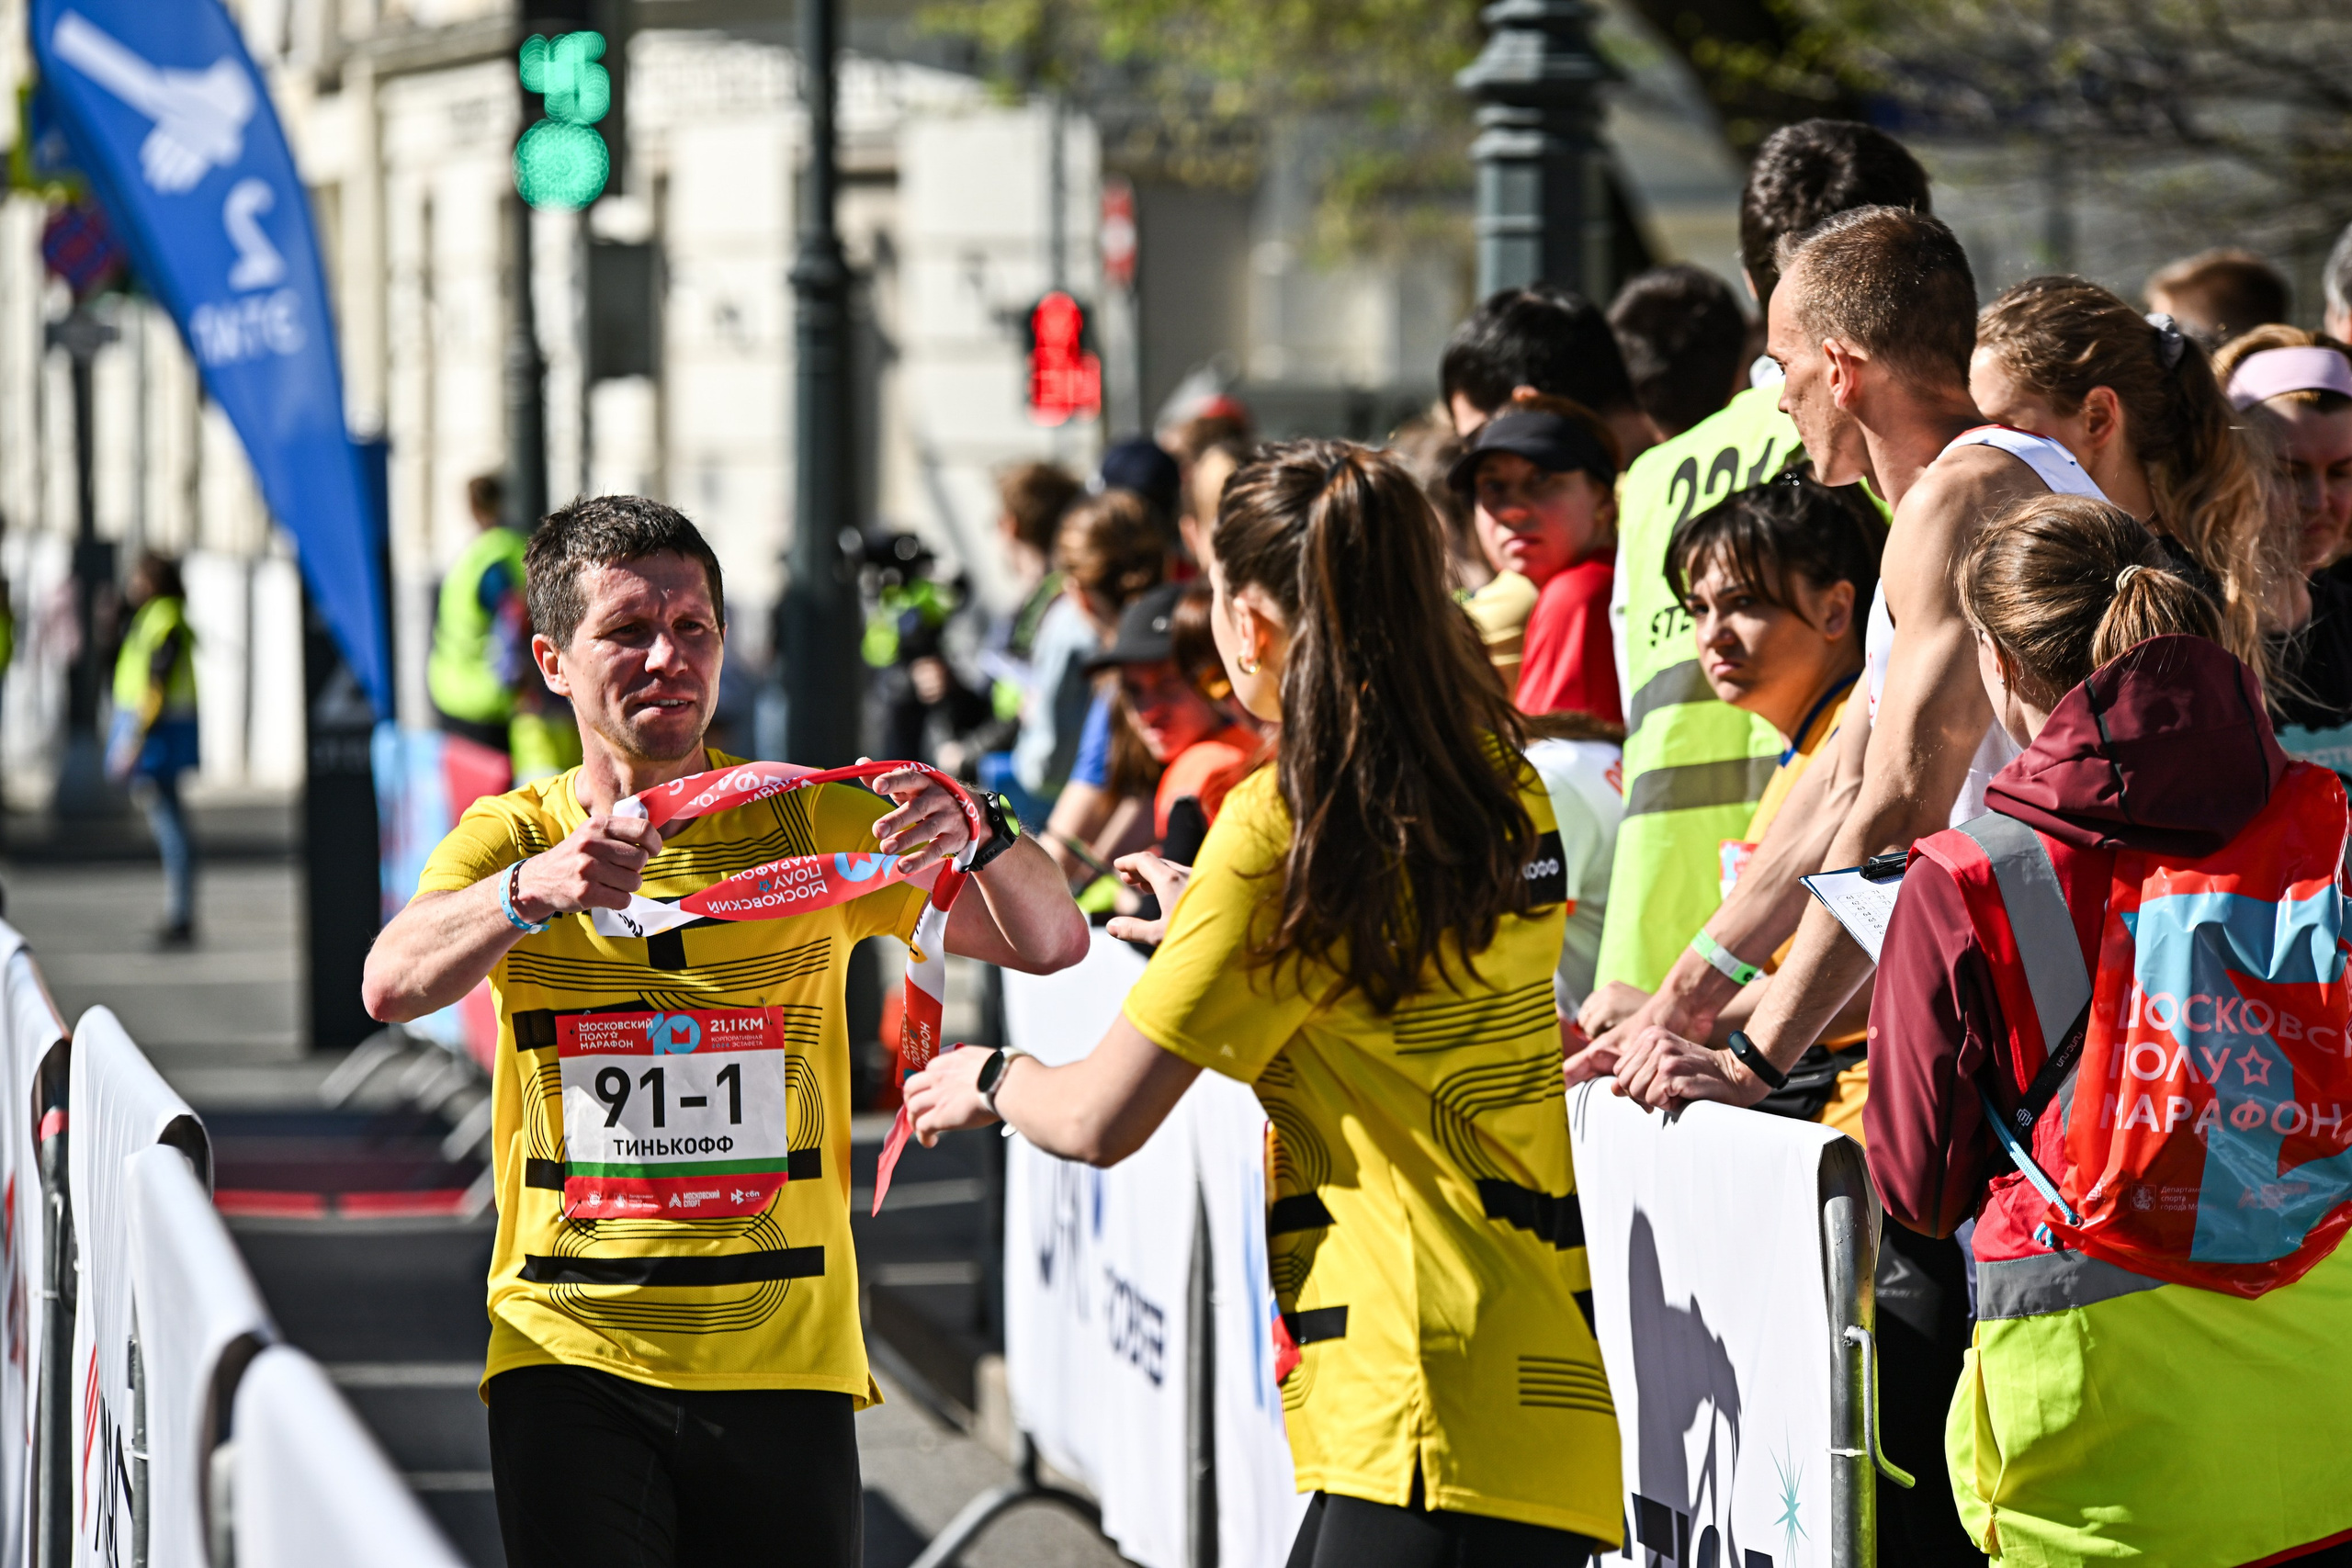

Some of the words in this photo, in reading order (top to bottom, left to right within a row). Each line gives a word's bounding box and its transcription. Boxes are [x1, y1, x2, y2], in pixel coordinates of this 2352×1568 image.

[774, 863, 822, 890] ПОЛУ
[707, 879, 829, 914] МОСКОВСКИЙ
[578, 1017, 653, 1032] МОСКОВСКИЙ
[710, 1020, 737, 1034] 21,1
[738, 1017, 763, 1031] КМ
[579, 1031, 611, 1042] ПОЛУ
[711, 1033, 763, 1043] КОРПОРАТИВНАЯ
[580, 1039, 634, 1051] МАРАФОН
[731, 1040, 763, 1049] ЭСТАФЕТА
[594, 1063, 742, 1128] 91-1
[613, 1135, 734, 1156] ТИНЬКОФФ
[683, 1189, 720, 1201] МОСКОВСКИЙ
[2161, 1194, 2186, 1203] спорта
[683, 1199, 701, 1208] СПОРТ
[2161, 1203, 2186, 1212] города
